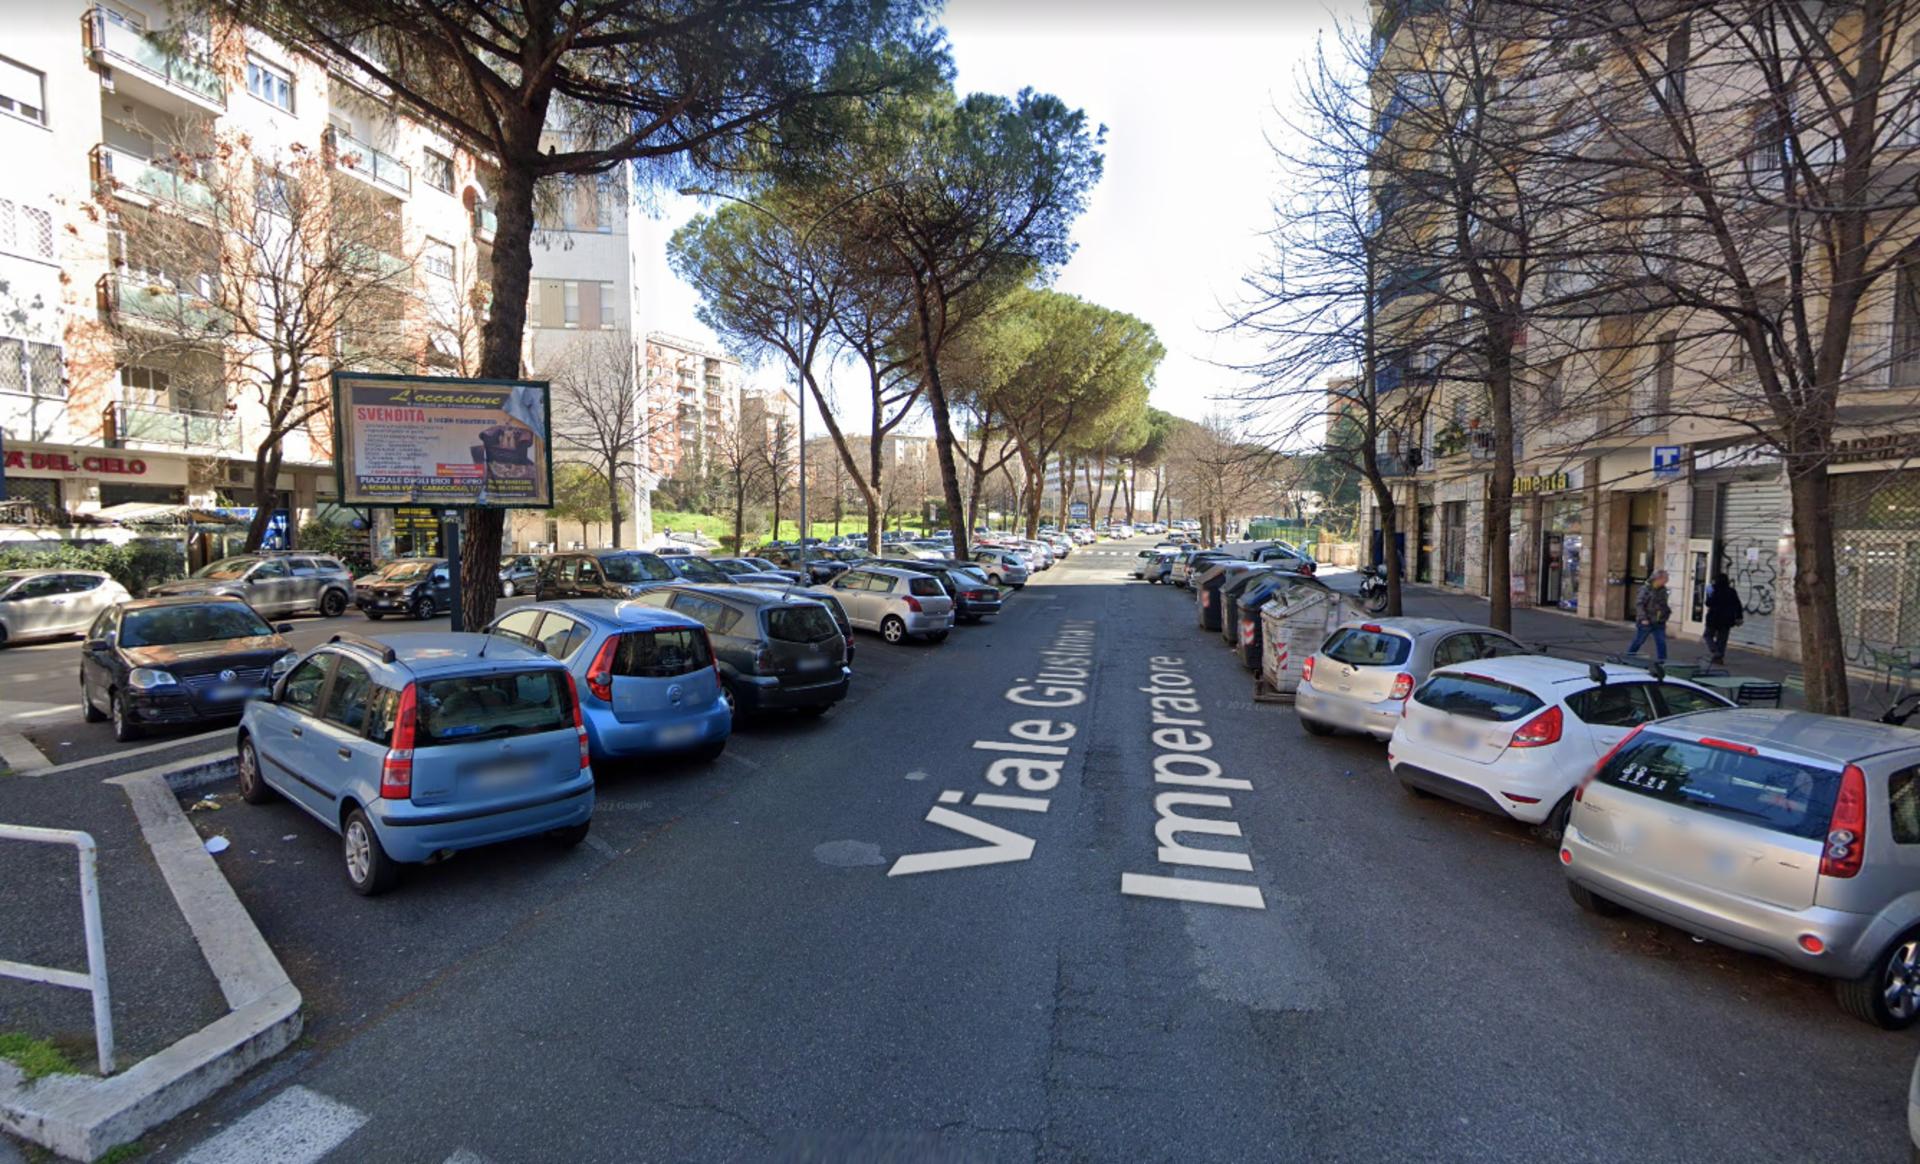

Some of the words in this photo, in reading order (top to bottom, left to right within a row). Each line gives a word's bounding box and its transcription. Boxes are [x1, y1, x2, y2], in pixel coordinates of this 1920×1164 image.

[389, 388, 502, 406] L'occasione
[358, 407, 425, 423] SVENDITA
[31, 453, 77, 472] DEL
[83, 456, 147, 475] CIELO
[1657, 448, 1678, 465] T
[360, 476, 402, 484] PIAZZALE
